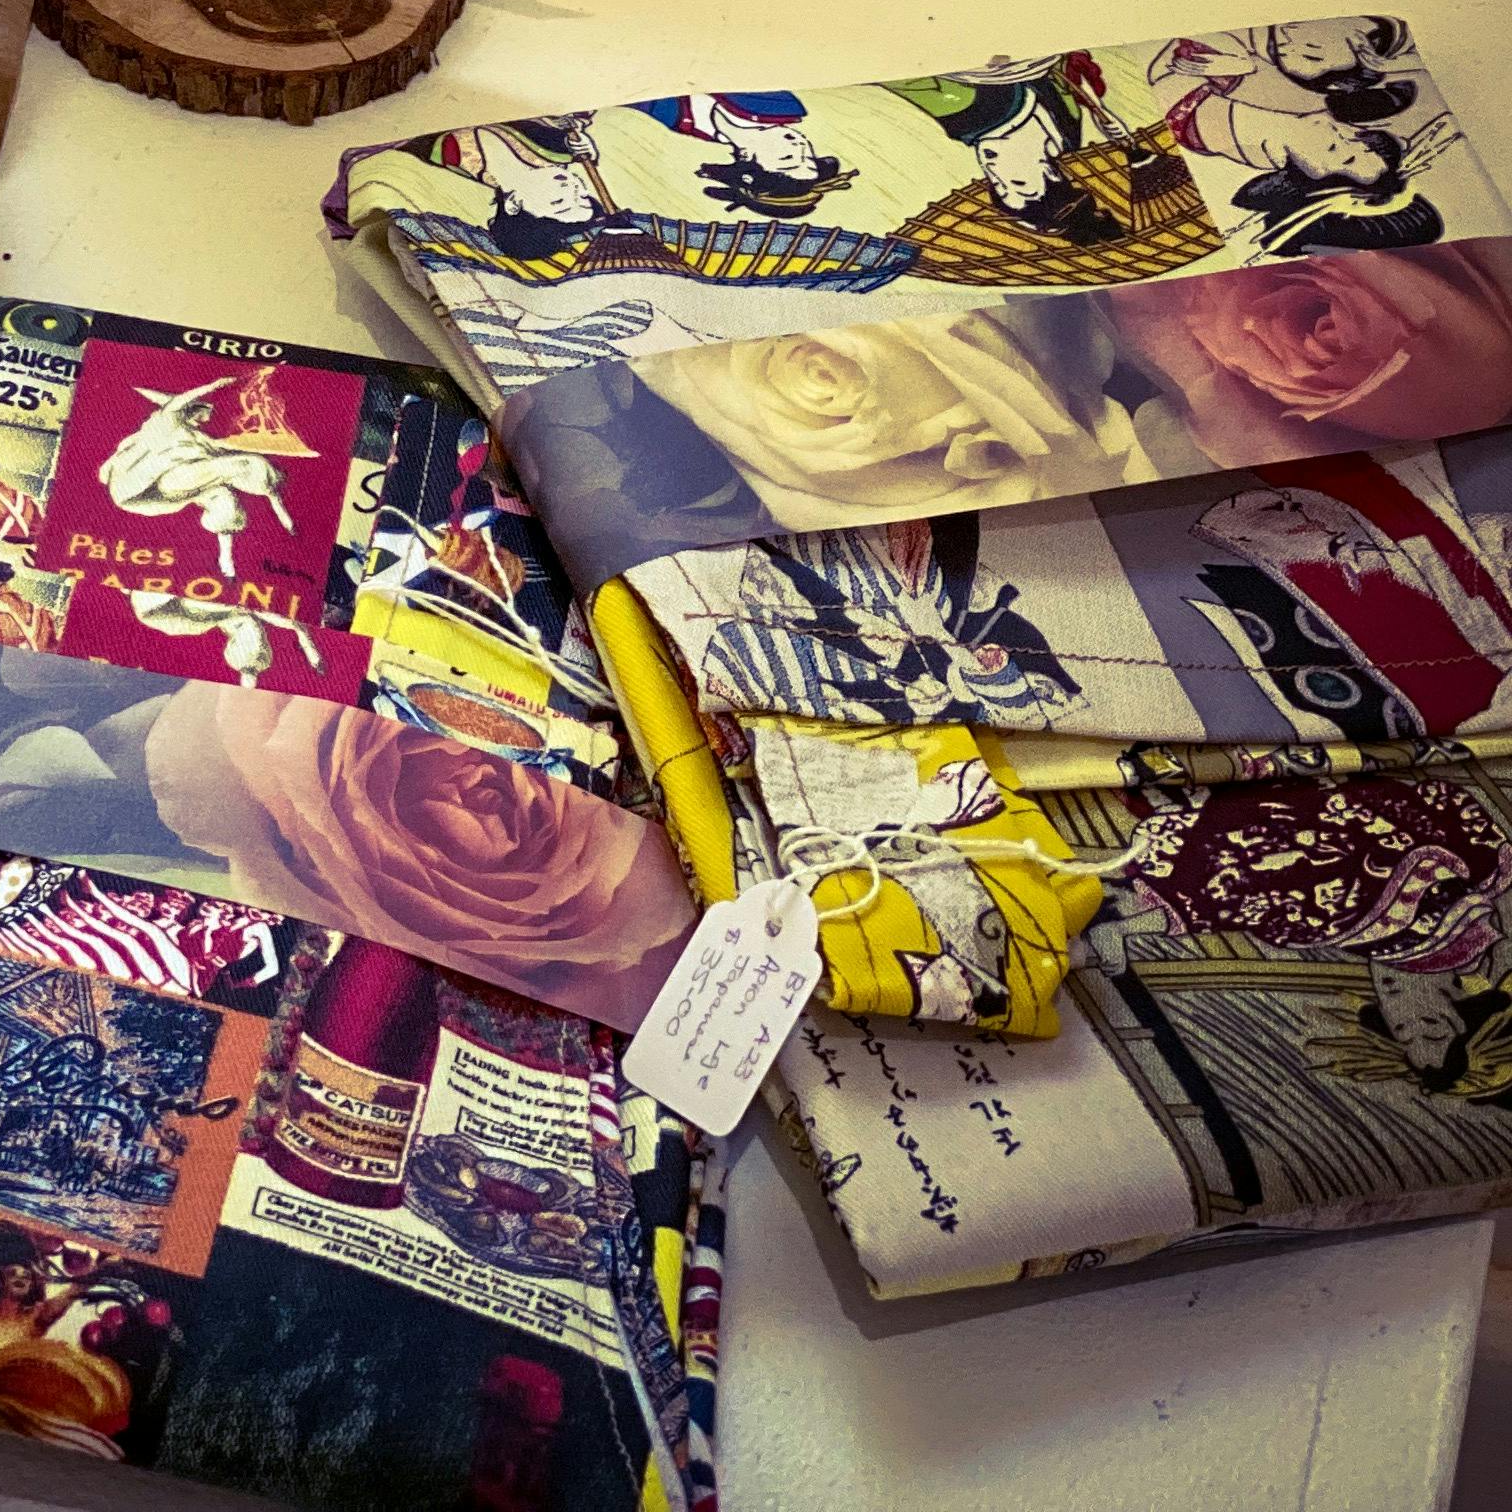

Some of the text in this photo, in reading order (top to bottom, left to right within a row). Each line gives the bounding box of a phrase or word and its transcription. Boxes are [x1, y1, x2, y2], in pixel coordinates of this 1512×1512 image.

[180, 329, 285, 361] CIRIO
[682, 954, 751, 1062] Japanese
[733, 954, 781, 1016] Apron
[324, 1090, 409, 1125] CATSUP
